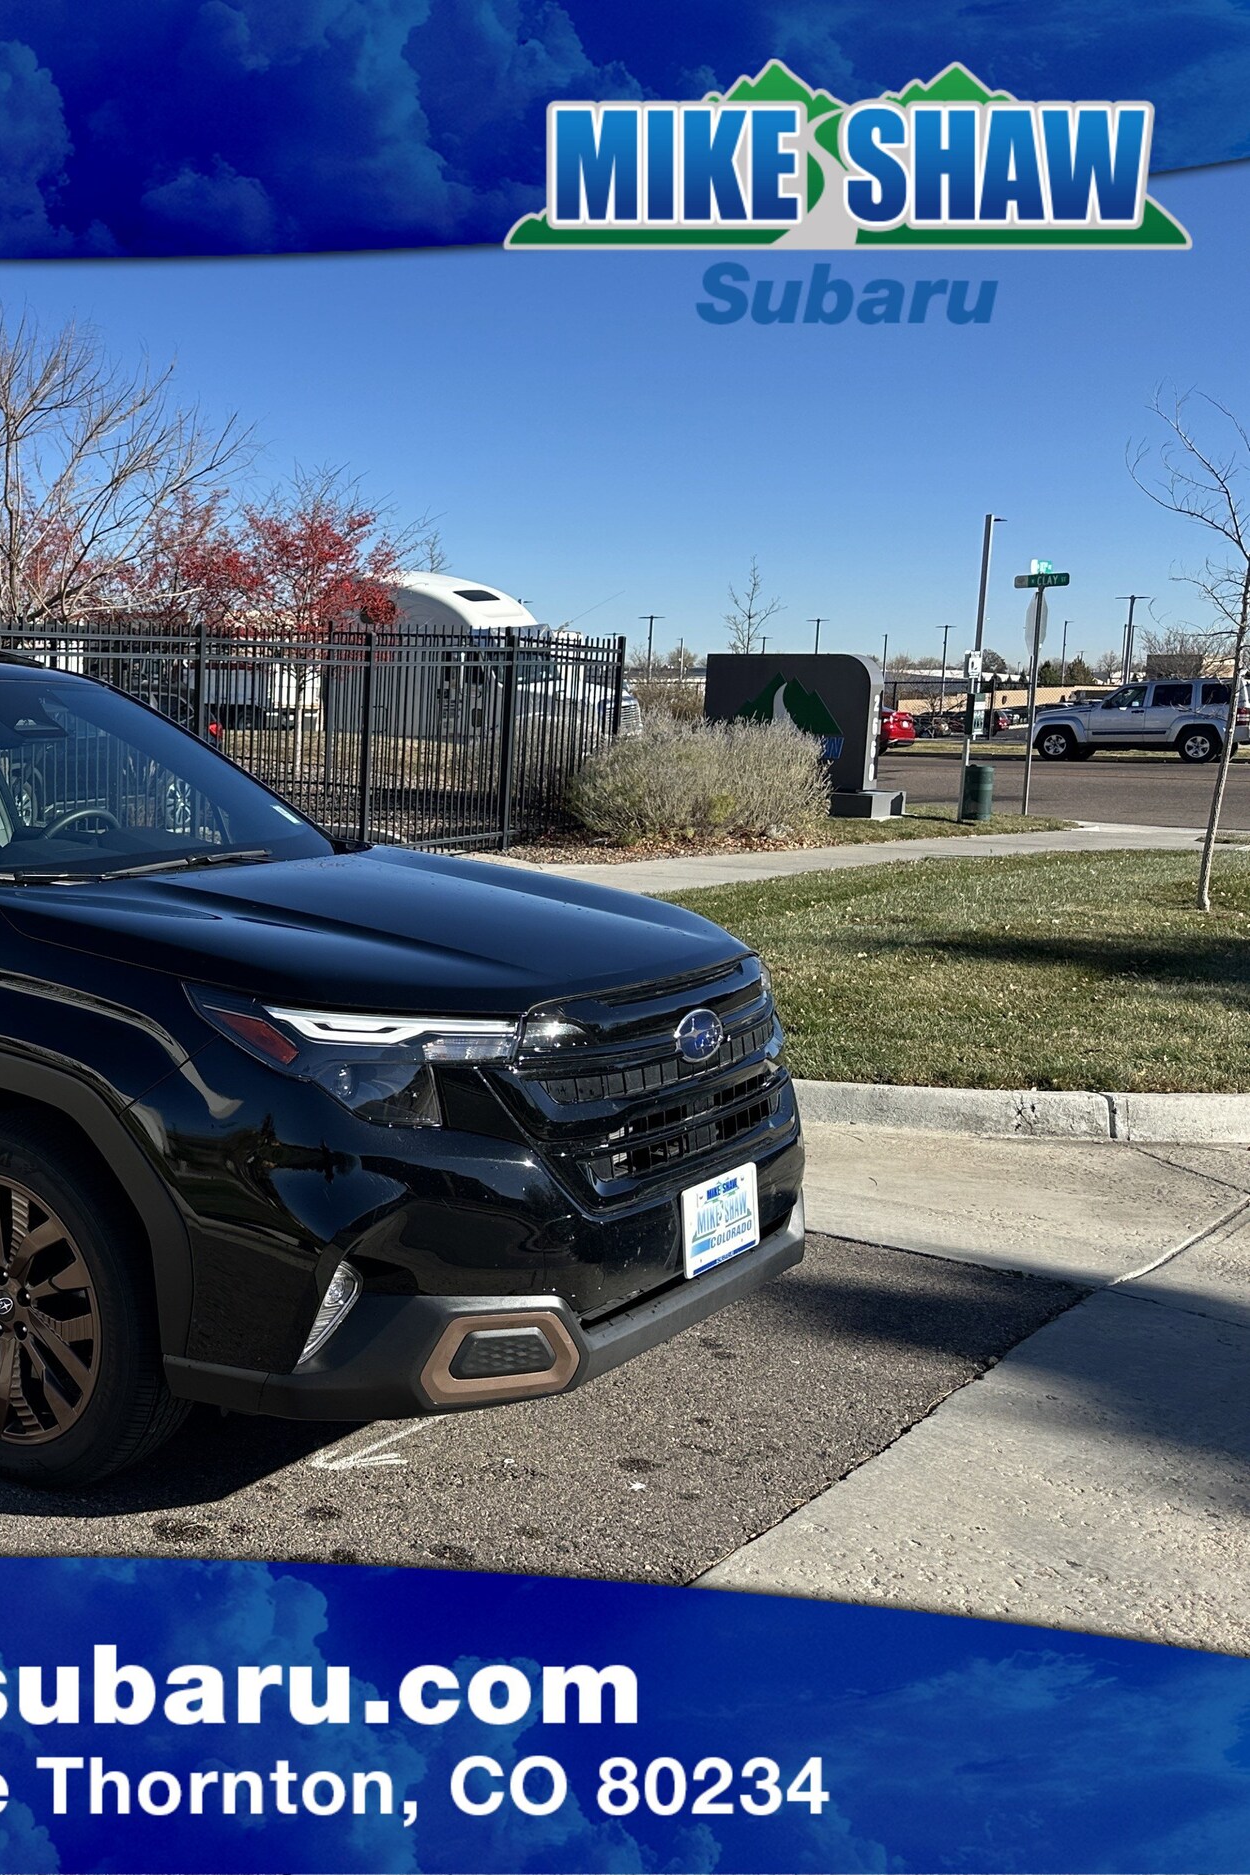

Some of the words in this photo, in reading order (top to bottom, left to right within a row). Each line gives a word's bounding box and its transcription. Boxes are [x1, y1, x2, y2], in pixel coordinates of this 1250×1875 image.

[1037, 575, 1058, 586] CLAY
[868, 694, 880, 782] 2660
[706, 1184, 721, 1200] MIKE
[697, 1203, 720, 1235] MIKE
[724, 1191, 748, 1223] SHAW
[710, 1219, 752, 1249] COLORADO
